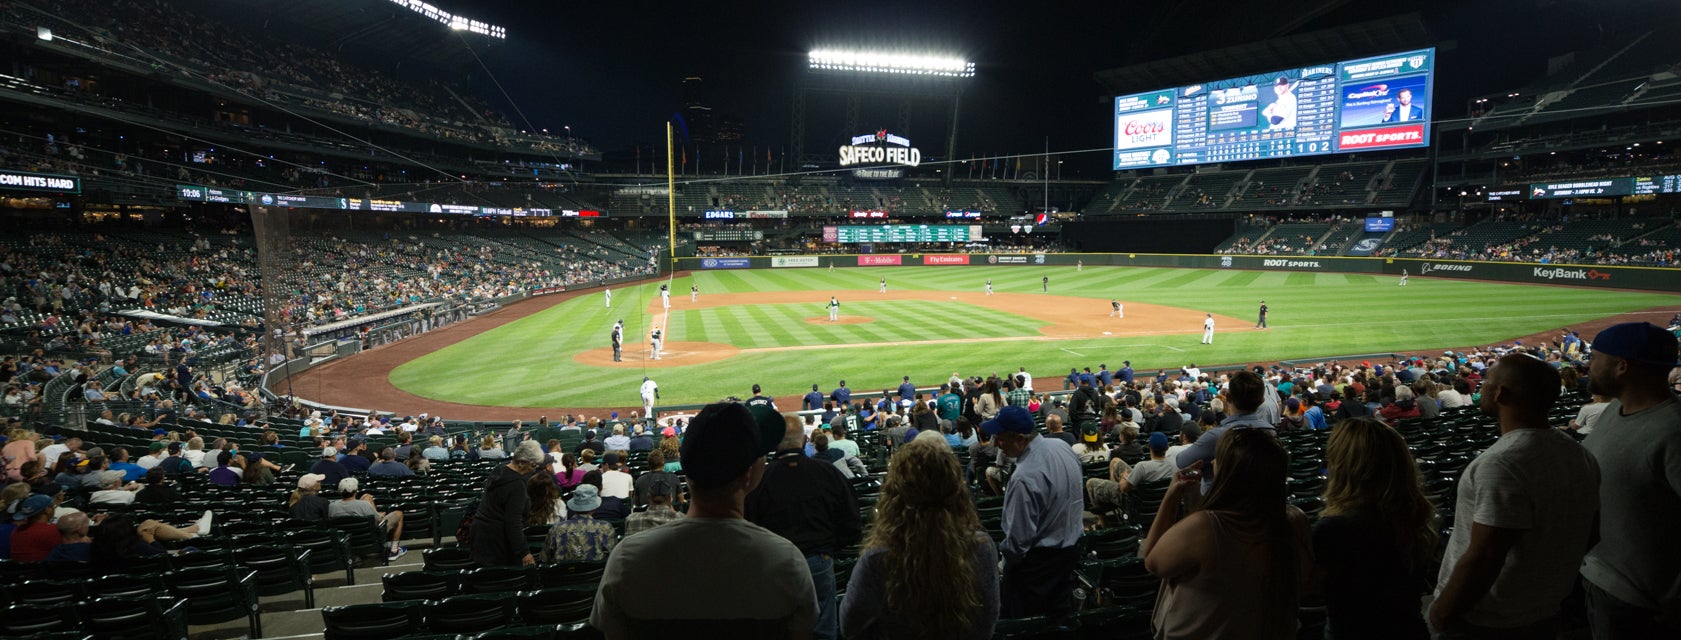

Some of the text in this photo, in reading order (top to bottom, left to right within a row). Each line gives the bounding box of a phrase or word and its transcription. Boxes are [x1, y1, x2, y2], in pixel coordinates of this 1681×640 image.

[1302, 67, 1333, 78] MARINERS
[1216, 93, 1258, 105] 3 ZUNINO
[1124, 119, 1165, 136] Coors
[1131, 134, 1158, 144] LIGHT
[1342, 133, 1376, 145] ROOT
[1298, 141, 1330, 153] 1 0 2
[839, 145, 921, 167] SAFECO FIELD
[23, 176, 47, 187] HITS
[47, 178, 74, 189] HARD
[940, 255, 964, 263] Emirates
[1263, 259, 1288, 267] ROOT
[1433, 263, 1473, 273] BOEING
[1533, 266, 1587, 281] KeyBank
[847, 418, 858, 432] 51
